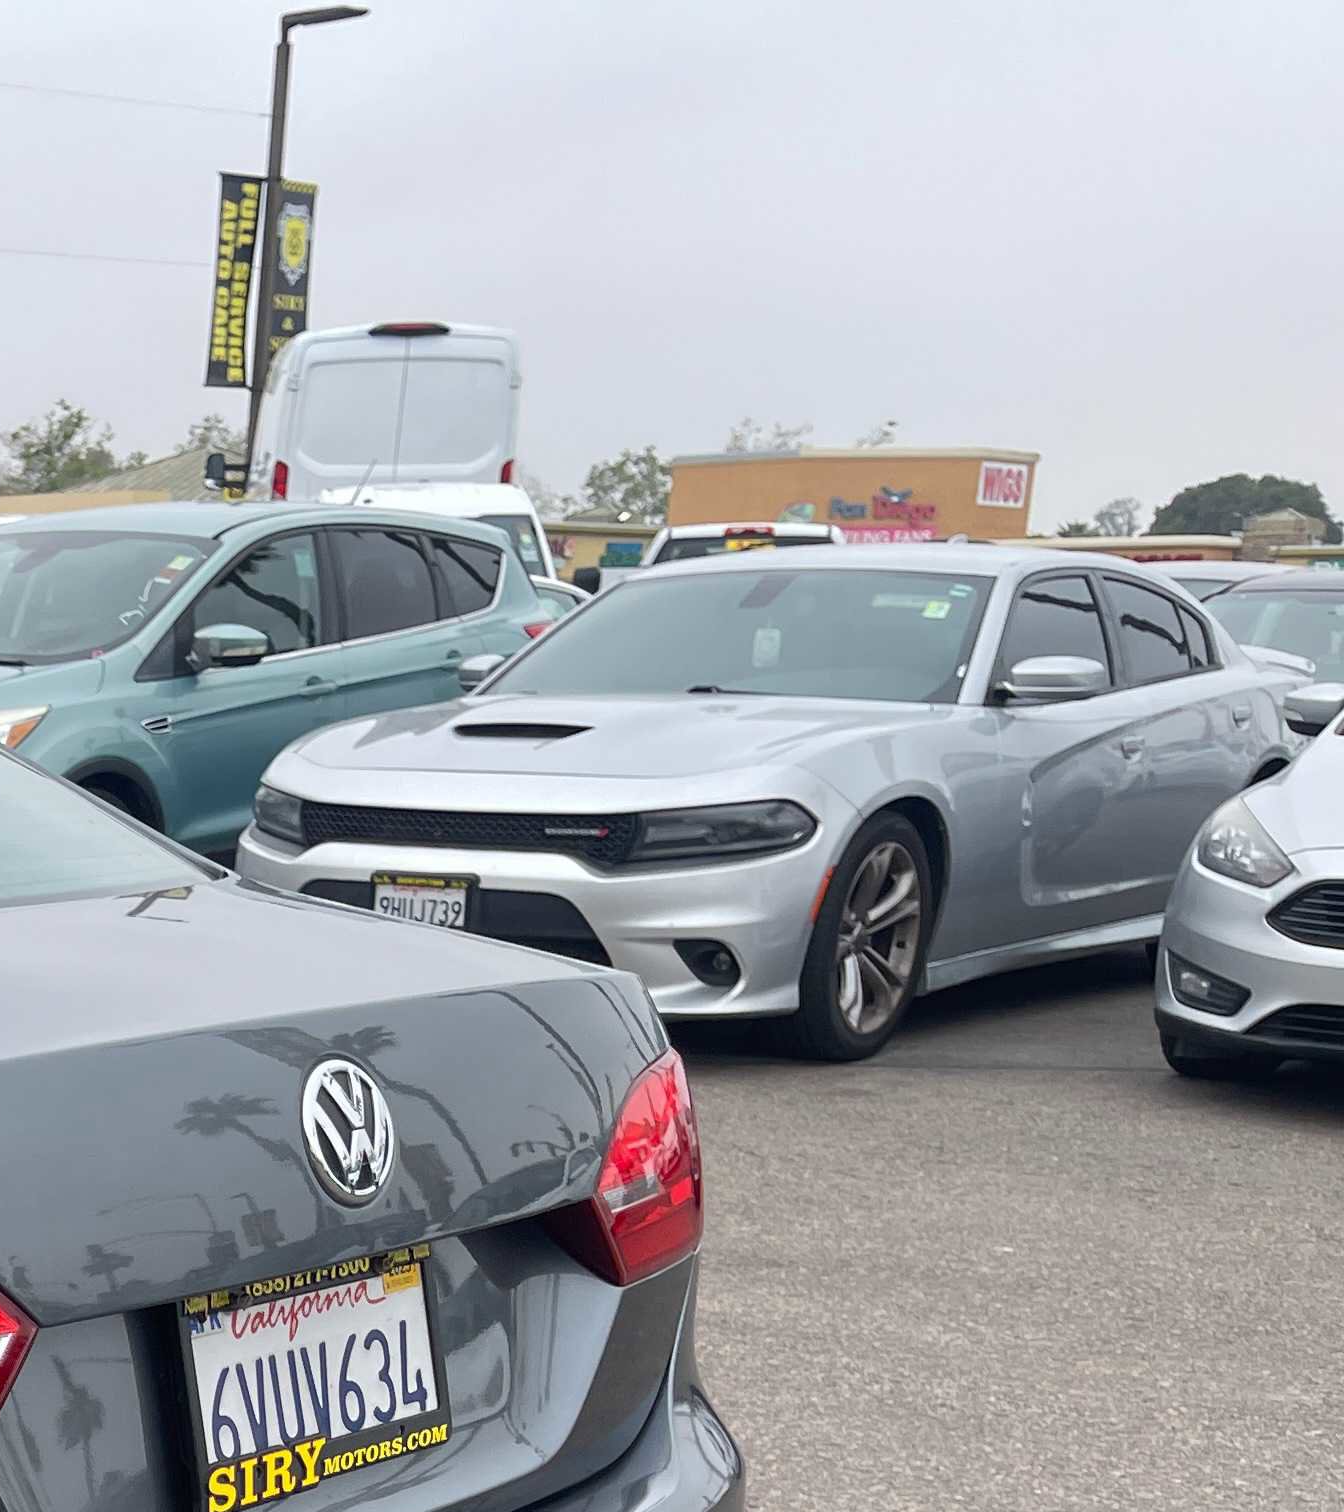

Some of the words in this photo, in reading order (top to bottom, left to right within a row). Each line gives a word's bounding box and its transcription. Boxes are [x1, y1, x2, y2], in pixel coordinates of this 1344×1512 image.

[217, 199, 239, 281] AUTO
[236, 182, 259, 248] FULL
[212, 286, 230, 361] CARE
[227, 261, 250, 382] SERVICE
[983, 467, 1024, 503] WIGS
[231, 1279, 386, 1341] California
[212, 1320, 428, 1460] 6VUV634
[322, 1424, 448, 1476] MOTORS.COM
